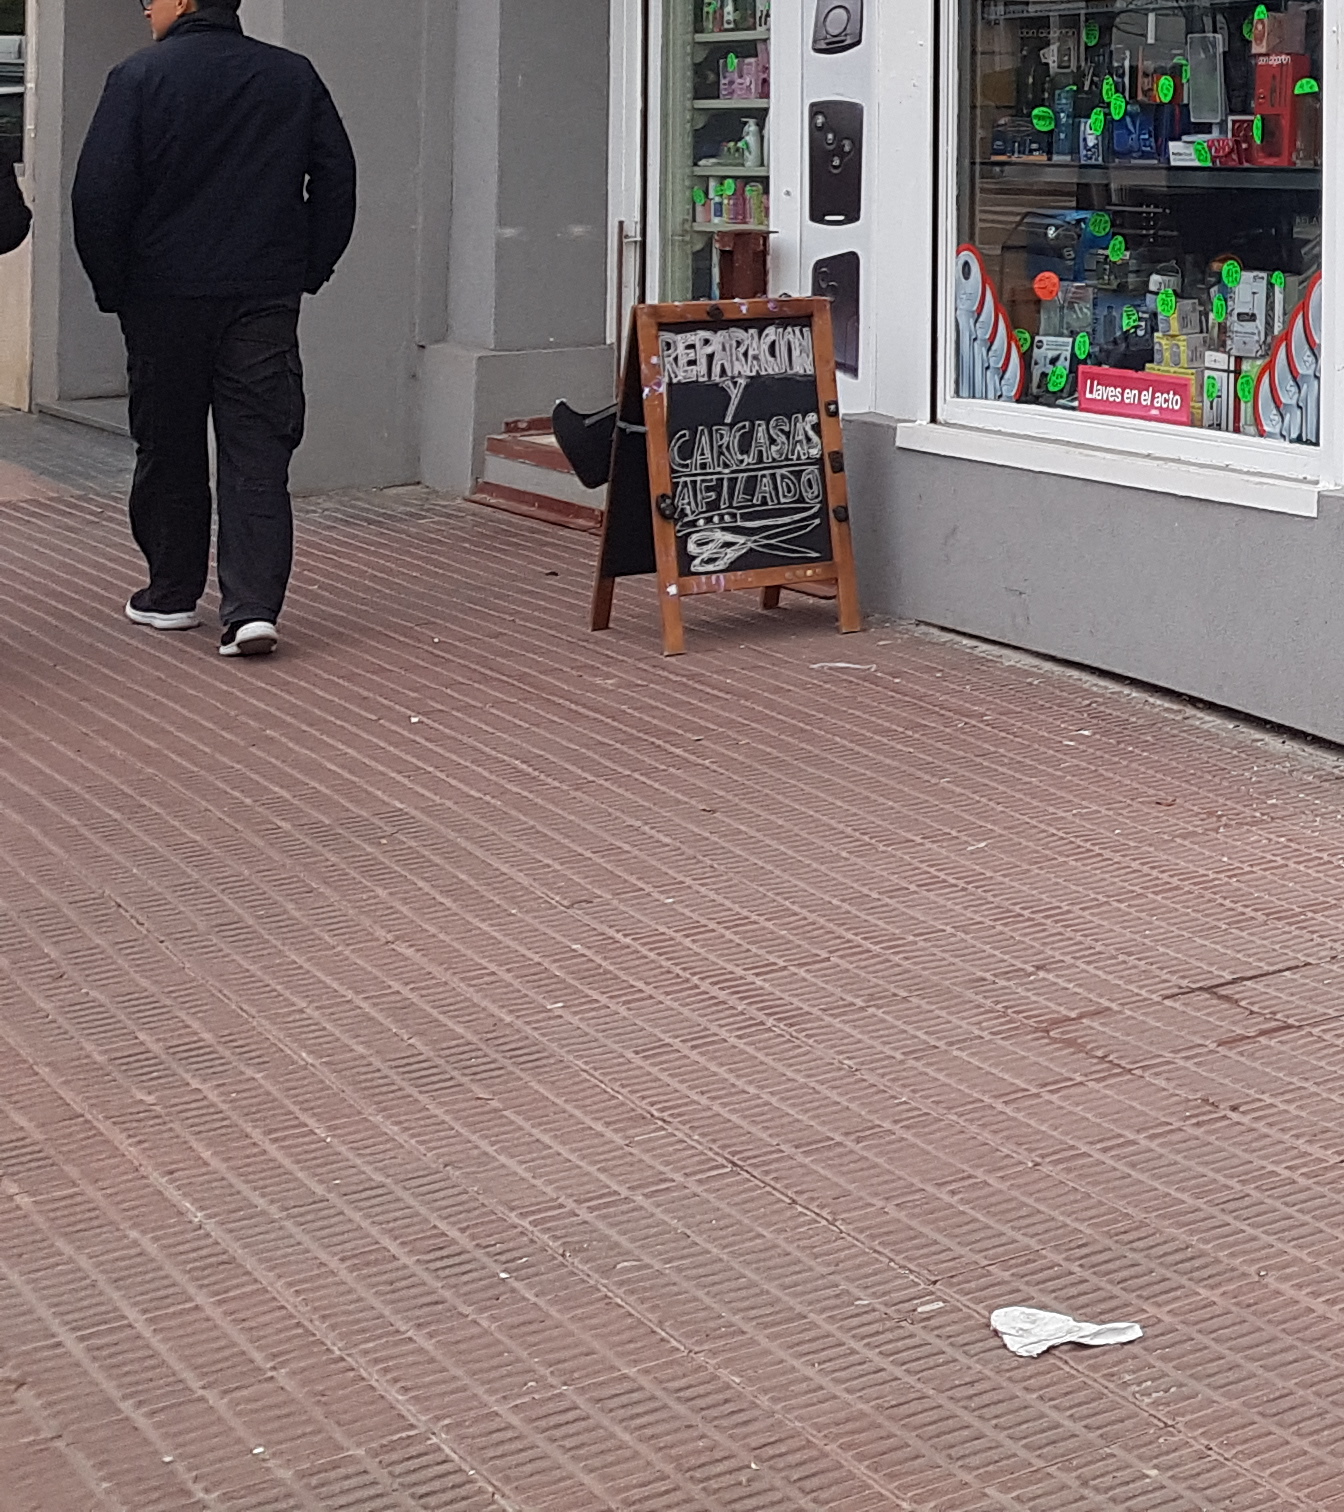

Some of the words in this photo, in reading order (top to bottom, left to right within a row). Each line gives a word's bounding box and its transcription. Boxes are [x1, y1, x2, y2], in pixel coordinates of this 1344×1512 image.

[659, 325, 815, 384] REPARACION
[722, 379, 746, 423] Y
[1086, 379, 1122, 402] Llaves
[1124, 389, 1138, 404] en
[1141, 387, 1152, 406] el
[1153, 390, 1181, 410] acto
[669, 412, 823, 472] CARCASAS
[674, 468, 823, 520] AFILADO
